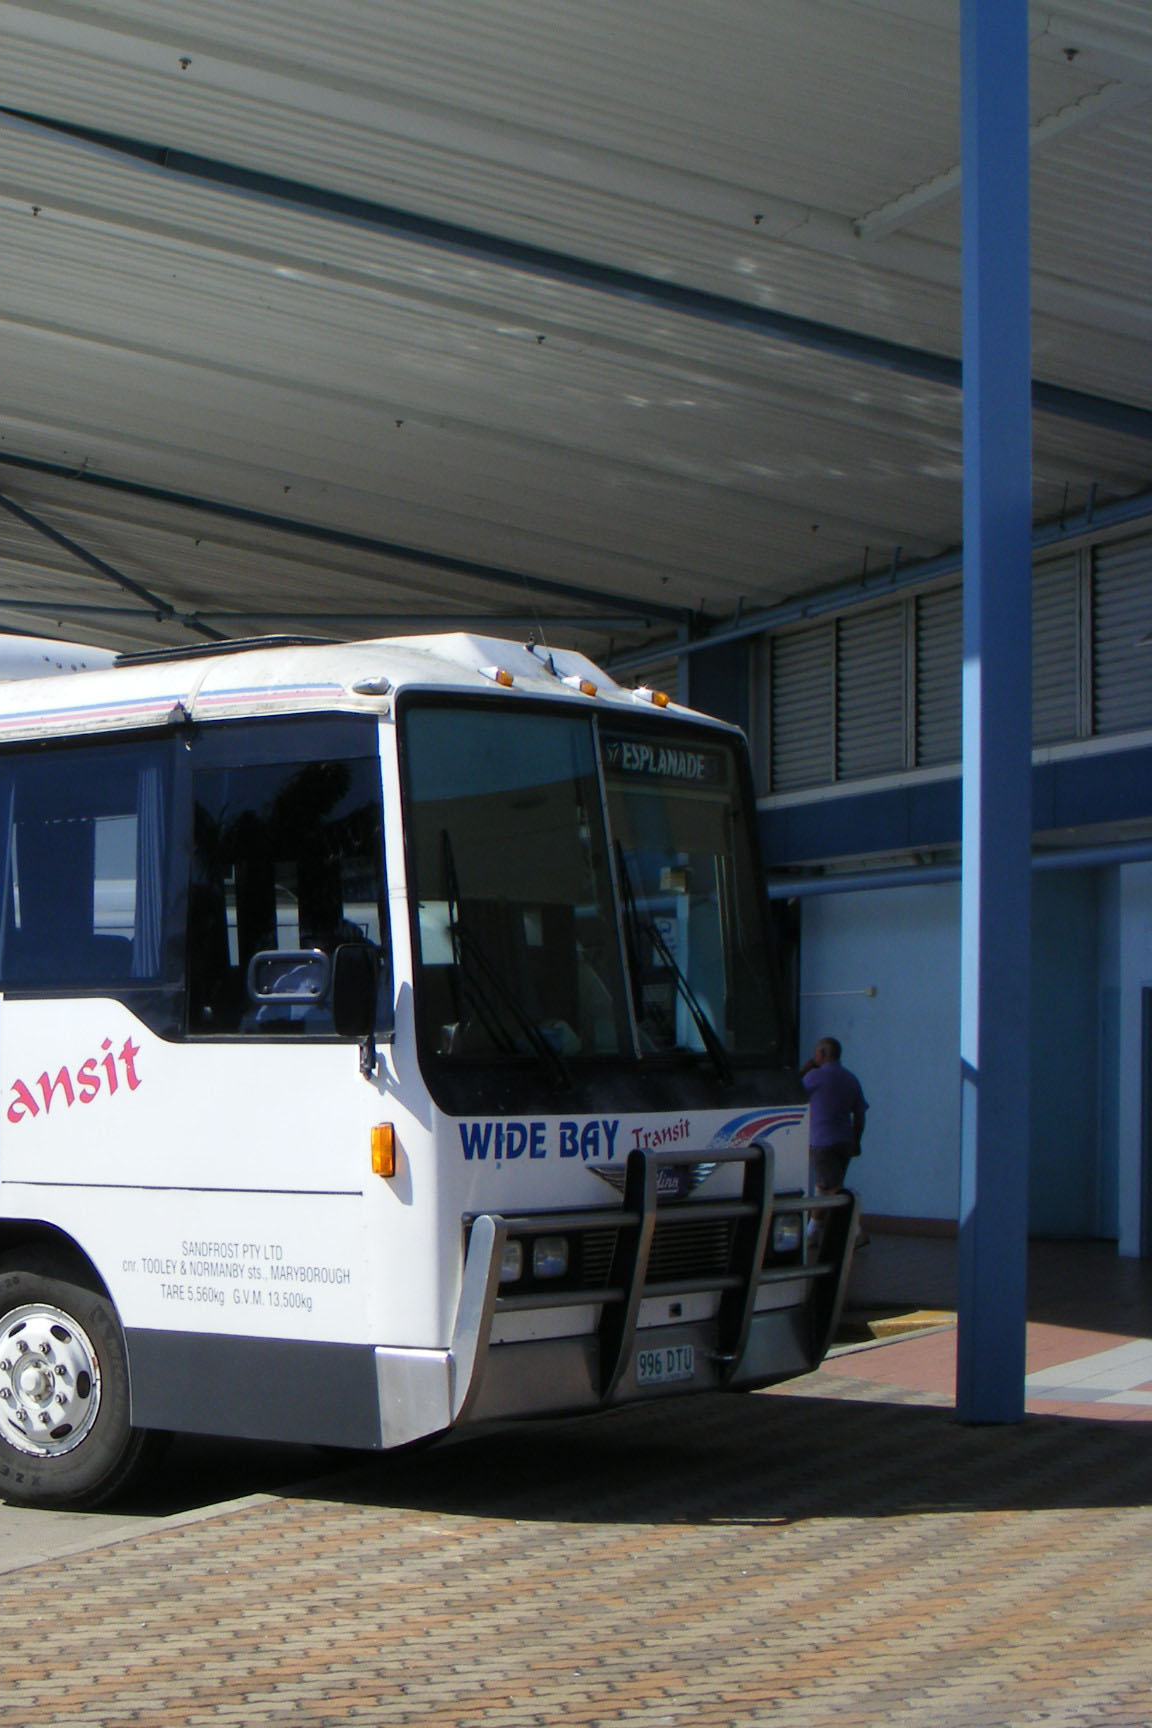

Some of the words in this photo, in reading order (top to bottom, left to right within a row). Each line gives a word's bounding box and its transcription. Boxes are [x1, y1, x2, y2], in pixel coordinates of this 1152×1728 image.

[622, 742, 705, 780] ESPLANADE
[7, 1036, 144, 1124] ansit
[458, 1122, 547, 1161] WIDE
[559, 1120, 620, 1161] BAY
[632, 1118, 691, 1150] Transit
[182, 1240, 239, 1259] SANDFROST
[242, 1243, 261, 1259] PTY
[264, 1245, 283, 1261] LTD
[122, 1260, 139, 1272] cnr.
[142, 1258, 178, 1275] TOOLEY
[180, 1260, 187, 1275] &
[189, 1261, 245, 1279] NORMANBY
[270, 1265, 351, 1285] MARYBOROUGH
[160, 1283, 185, 1300] TARE
[233, 1288, 265, 1306] G.V.M.
[639, 1353, 663, 1377] 996
[666, 1347, 692, 1372] DTU
